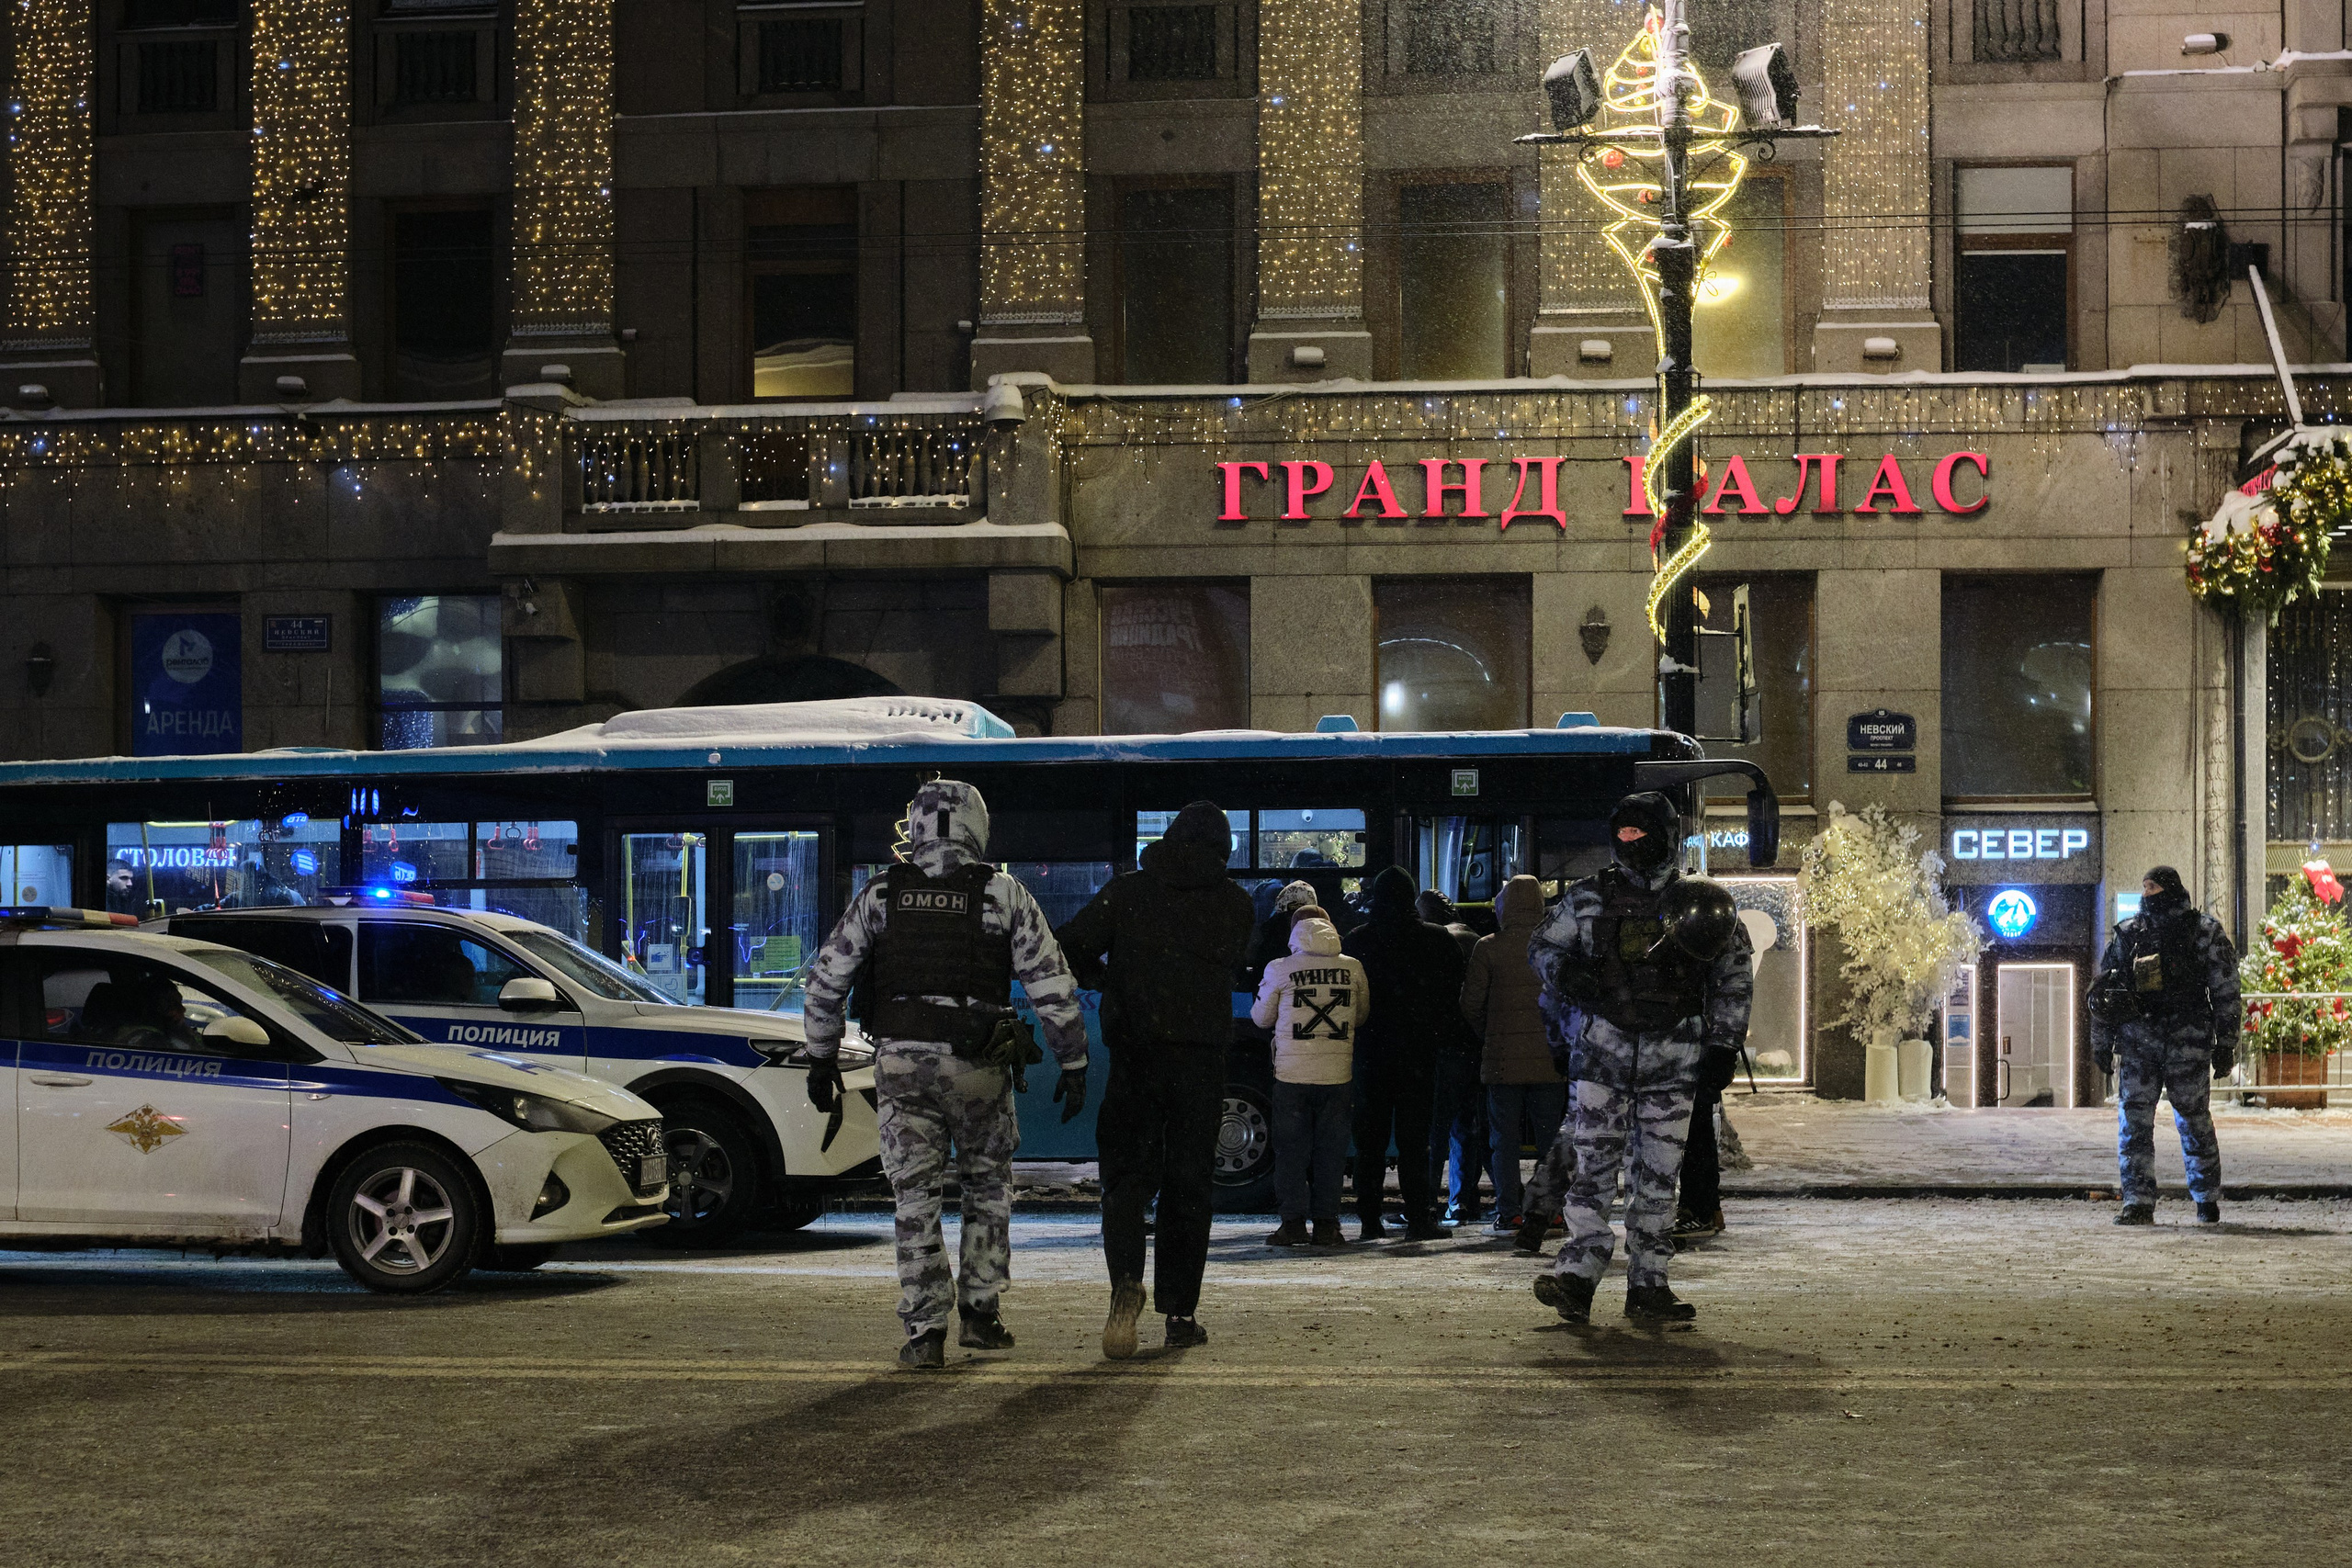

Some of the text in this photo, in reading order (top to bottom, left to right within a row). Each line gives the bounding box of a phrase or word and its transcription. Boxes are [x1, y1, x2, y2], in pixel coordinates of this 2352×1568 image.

[1216, 457, 1566, 530] ГРАНД
[146, 710, 234, 739] АРЕНДА
[1860, 723, 1905, 735] НЕВСКИЙ
[1874, 758, 1888, 770] 44
[1710, 830, 1749, 848] КАФ
[1953, 829, 2087, 860] СЕВЕР
[116, 847, 235, 868] СТОЛОВАЯ
[901, 893, 964, 909] ОМОН
[1289, 968, 1351, 987] WHITE
[447, 1025, 560, 1048] ПОЛИЦИЯ
[85, 1051, 222, 1078] ПОЛИЦИЯ
